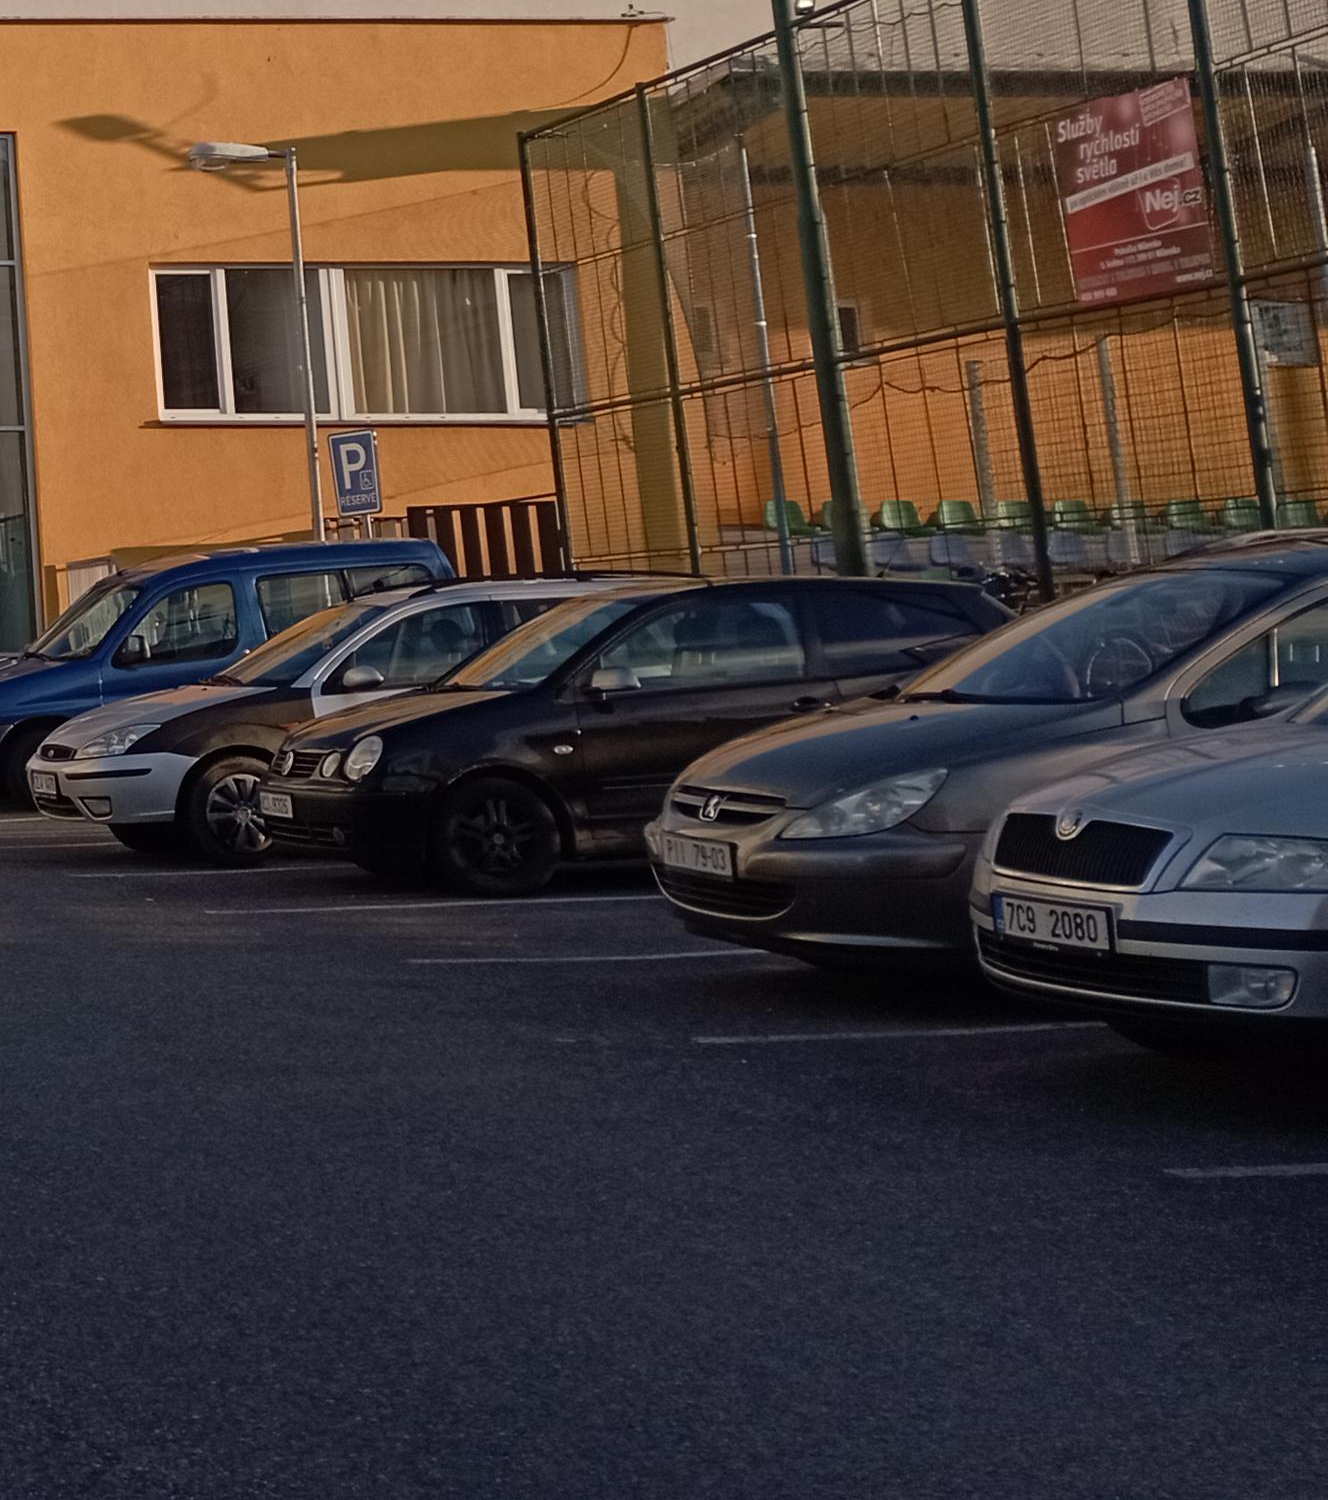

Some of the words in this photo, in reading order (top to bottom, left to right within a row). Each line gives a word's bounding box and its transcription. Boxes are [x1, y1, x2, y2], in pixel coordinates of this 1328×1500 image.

[1057, 113, 1103, 143] Služby
[1079, 123, 1140, 163] rychlostí
[1076, 156, 1118, 184] světla
[1144, 185, 1202, 213] Nej.cz
[339, 442, 366, 490] P
[1006, 902, 1036, 934] 7C9
[1049, 909, 1098, 943] 2080
